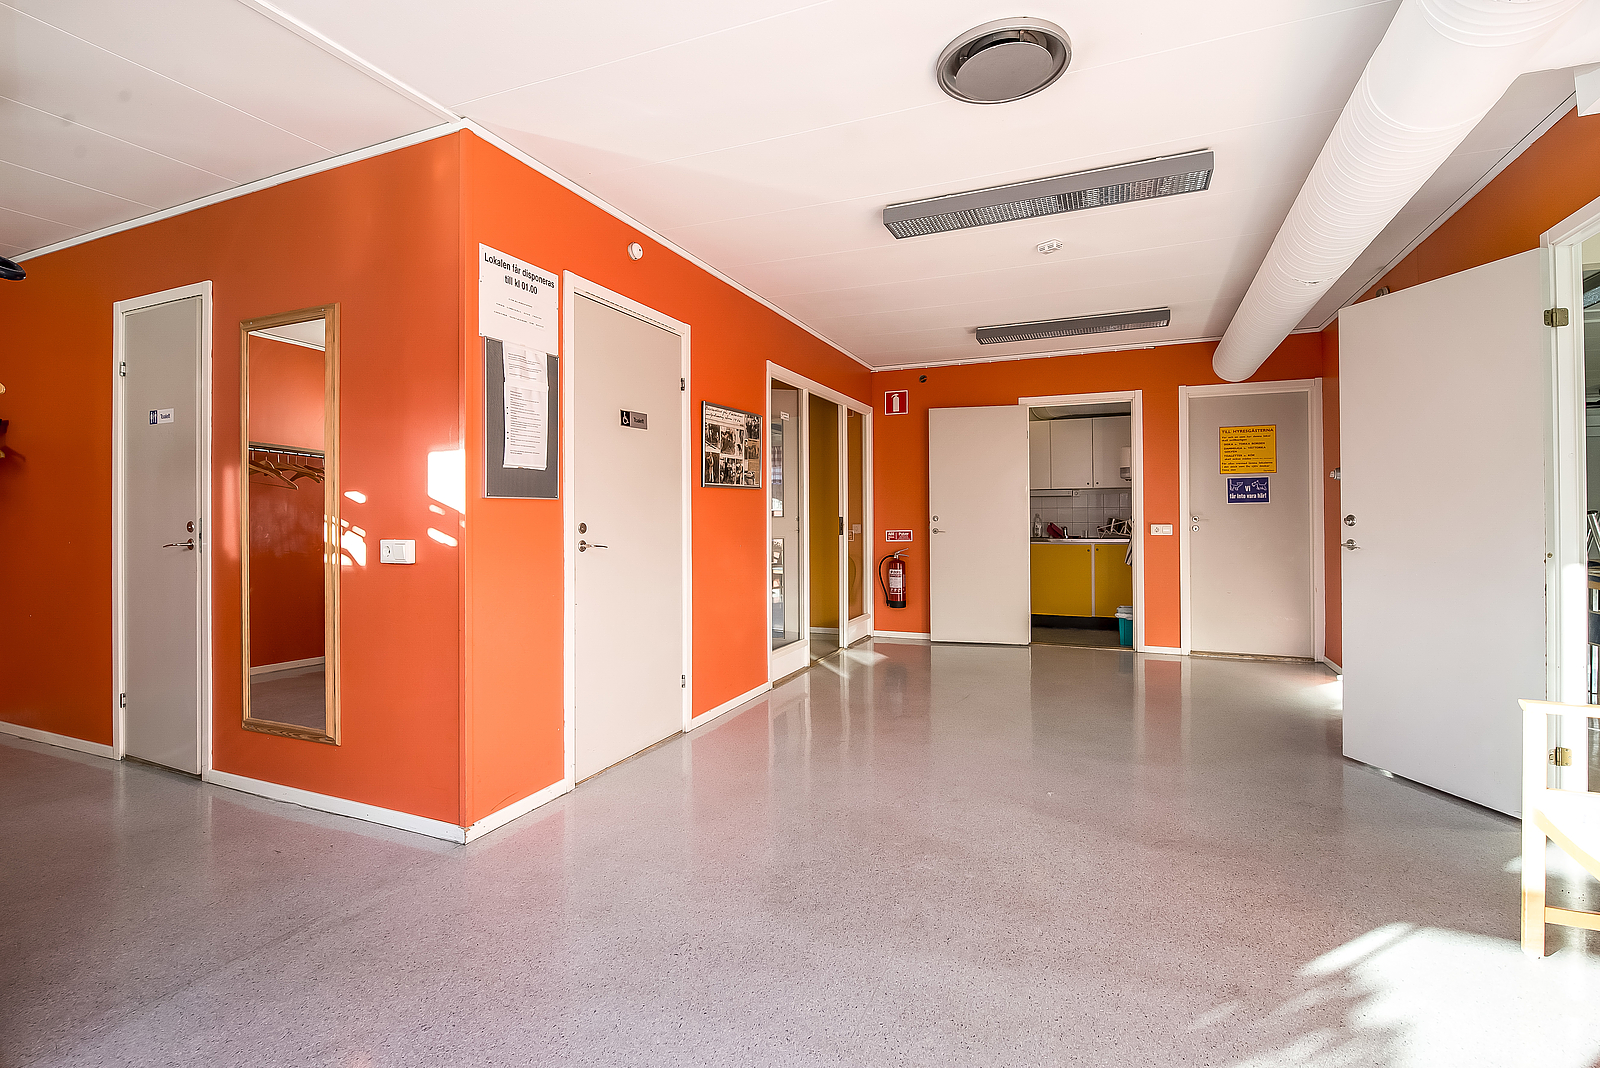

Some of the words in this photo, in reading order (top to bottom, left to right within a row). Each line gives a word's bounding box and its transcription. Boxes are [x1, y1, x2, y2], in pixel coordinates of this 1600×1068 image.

[484, 252, 511, 271] Lokalen
[512, 263, 522, 275] får
[522, 268, 555, 289] disponeras
[504, 275, 513, 286] till
[514, 278, 521, 288] kl
[521, 281, 538, 295] 01.00
